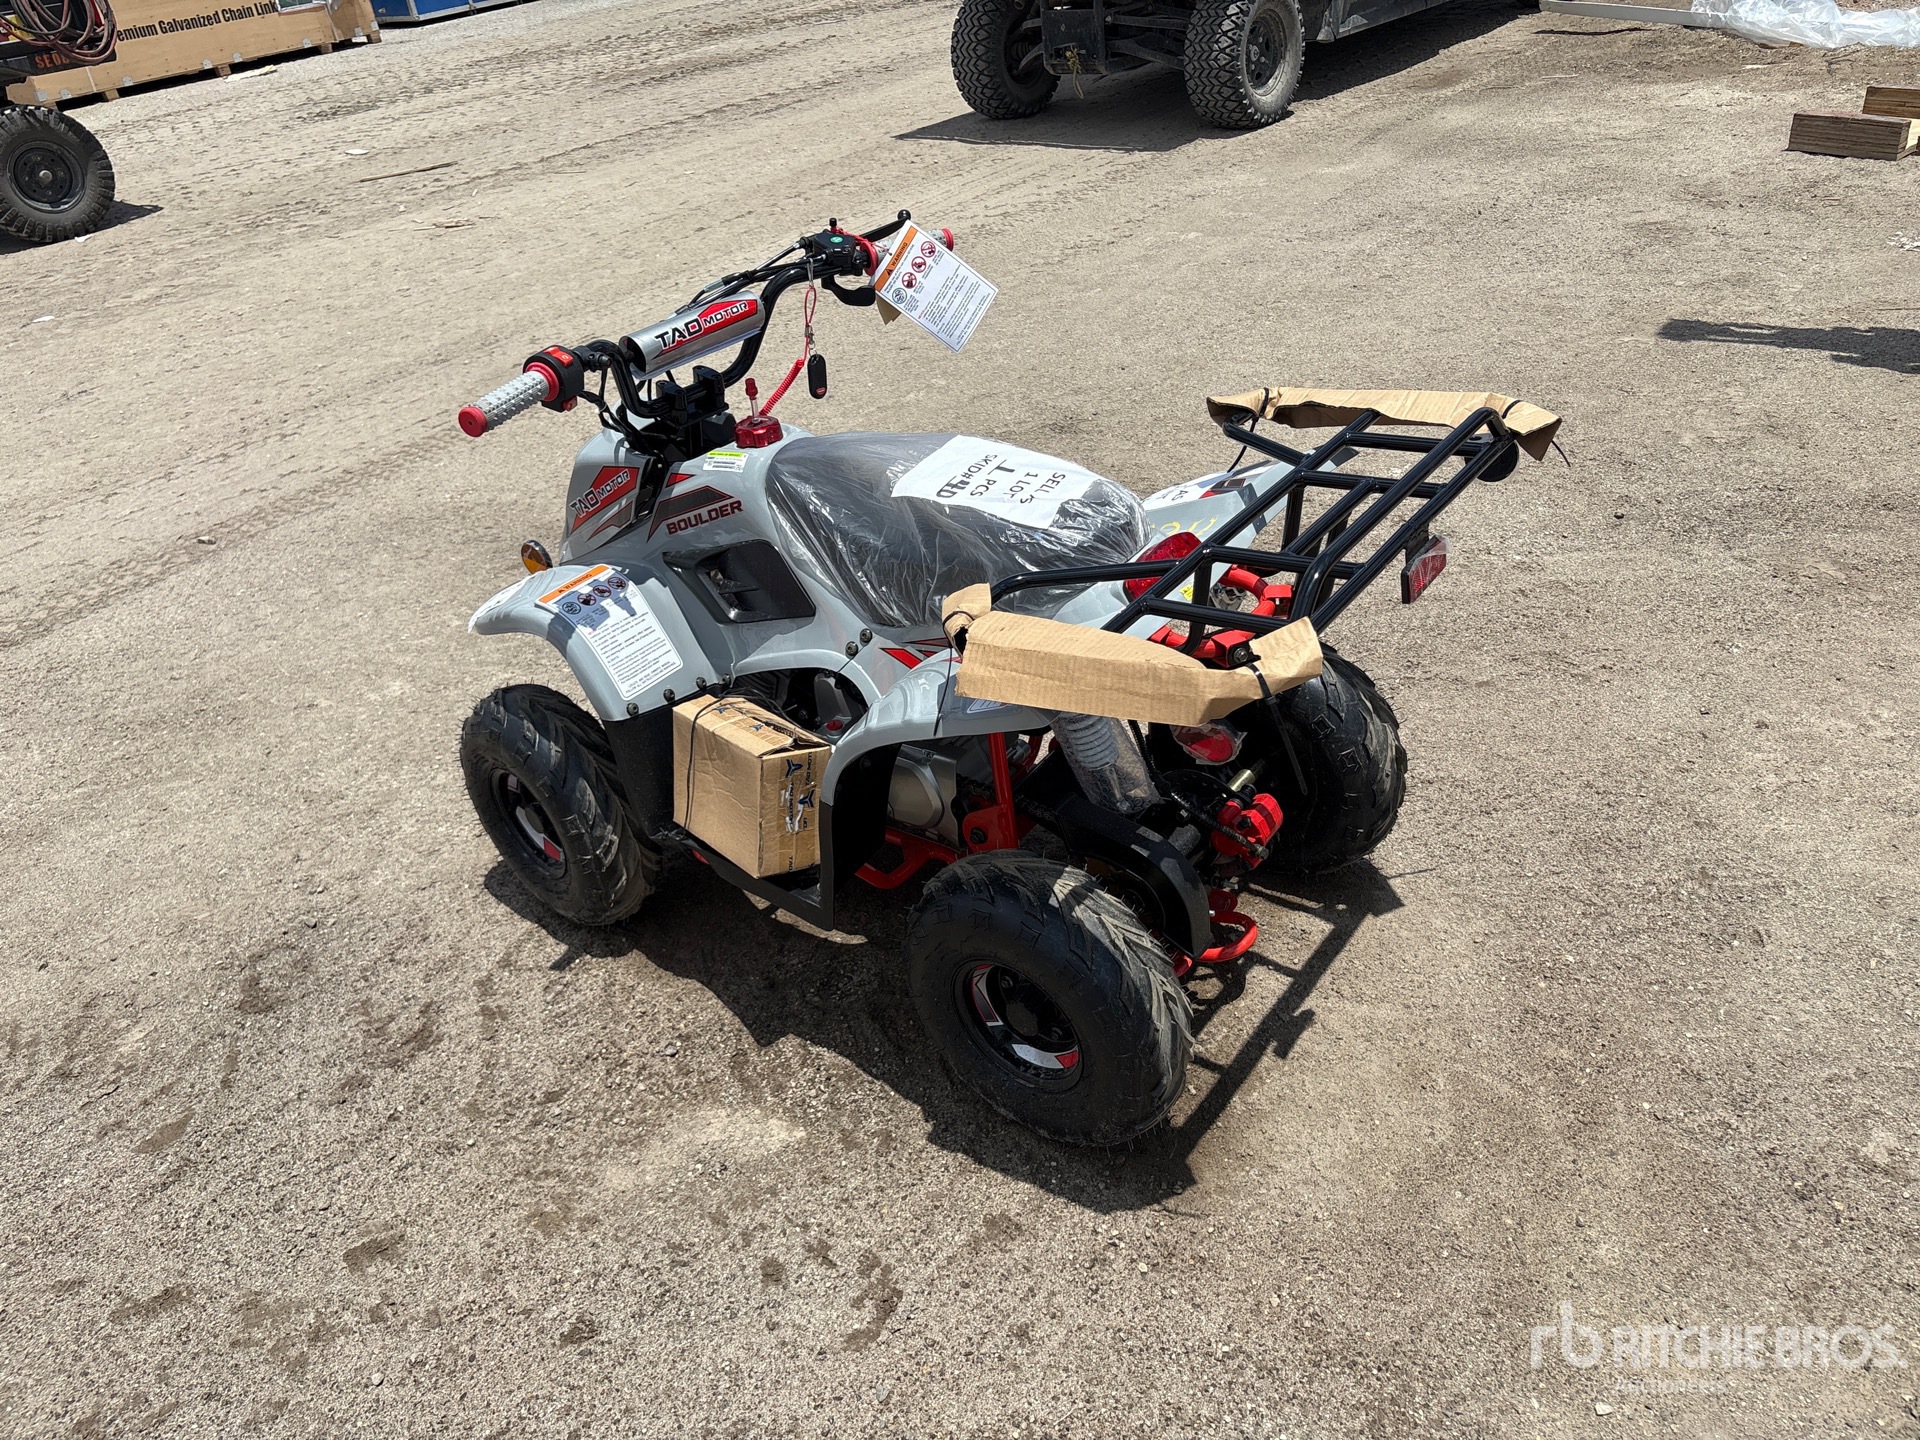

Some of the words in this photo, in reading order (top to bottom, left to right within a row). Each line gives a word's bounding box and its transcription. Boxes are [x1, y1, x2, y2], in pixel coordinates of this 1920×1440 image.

[117, 24, 158, 42] emium
[158, 11, 221, 34] Galvanized
[221, 5, 255, 22] Chain
[253, 0, 279, 16] Link
[892, 242, 908, 266] WARNING
[655, 318, 702, 349] TAO
[703, 301, 749, 328] MOTOR
[569, 488, 600, 518] TAO
[596, 469, 631, 498] MOTOR
[970, 479, 997, 497] PCS
[1003, 480, 1031, 499] LOT
[1034, 472, 1066, 493] SELL
[666, 500, 743, 536] BOULDER
[565, 573, 592, 590] WARNING
